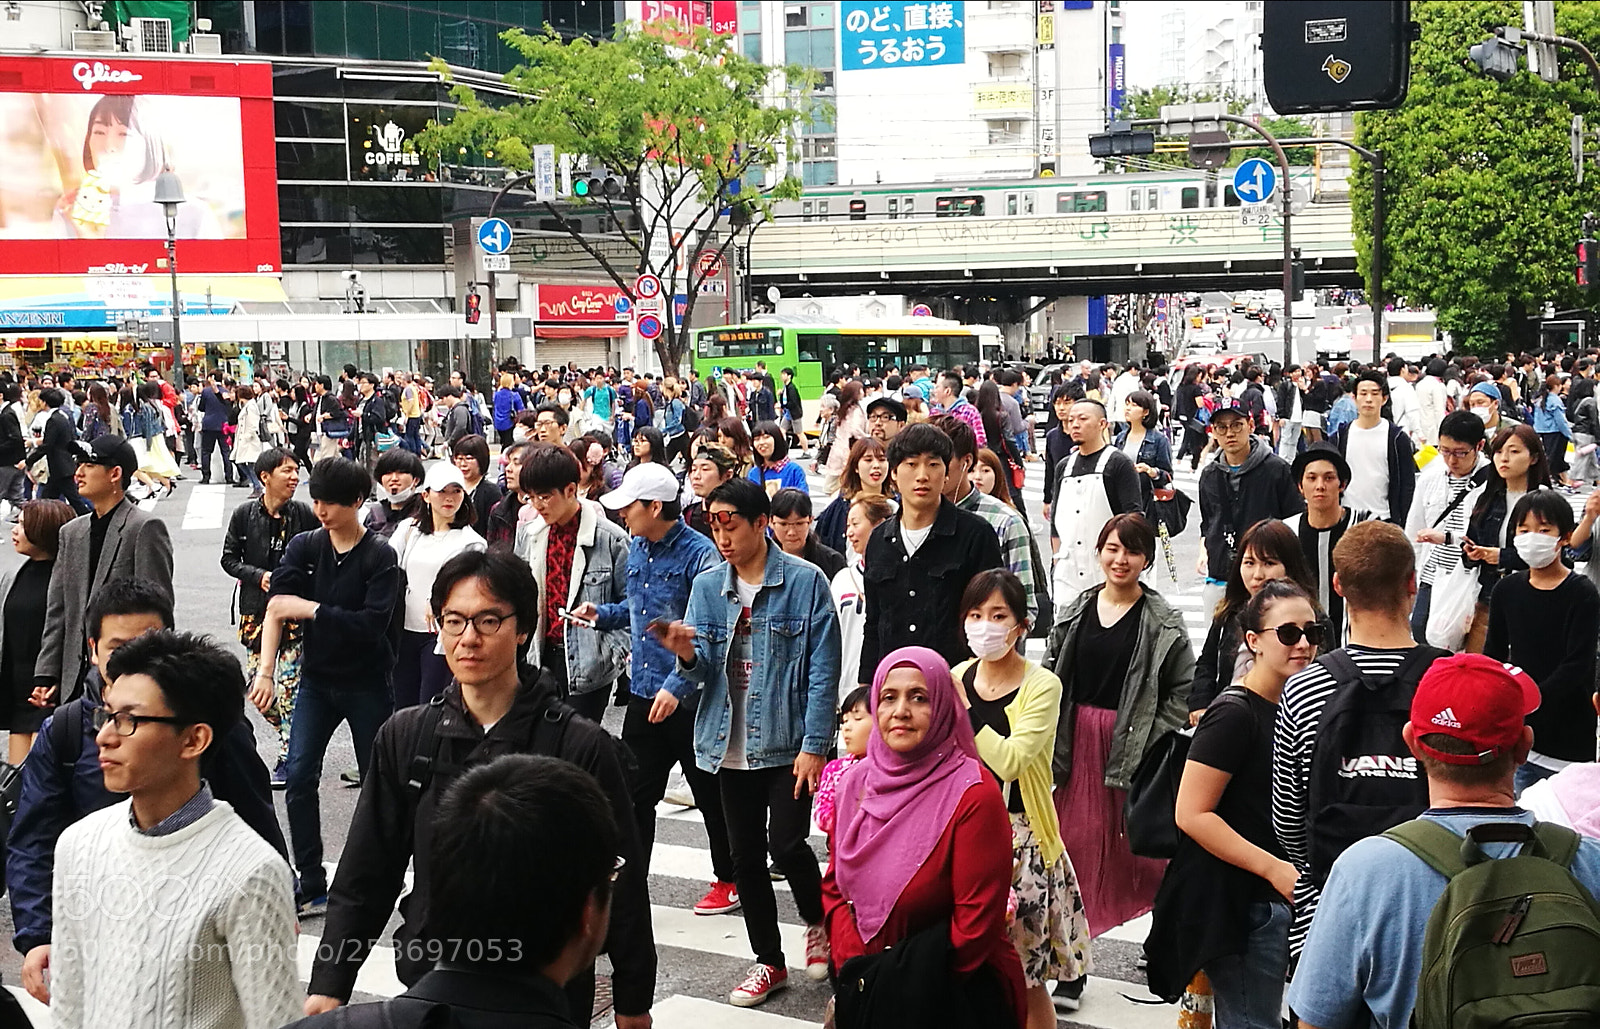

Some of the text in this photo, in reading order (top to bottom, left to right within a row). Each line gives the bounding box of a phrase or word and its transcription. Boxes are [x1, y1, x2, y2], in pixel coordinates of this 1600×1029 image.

[846, 2, 963, 33] のど、直接、
[858, 35, 946, 65] うるおう
[73, 62, 143, 90] Glico
[365, 152, 420, 165] COFFEE
[1080, 222, 1111, 239] JR
[63, 340, 96, 352] TAX
[100, 340, 133, 352] Free
[1431, 717, 1462, 729] adidas
[1341, 755, 1418, 772] VANS
